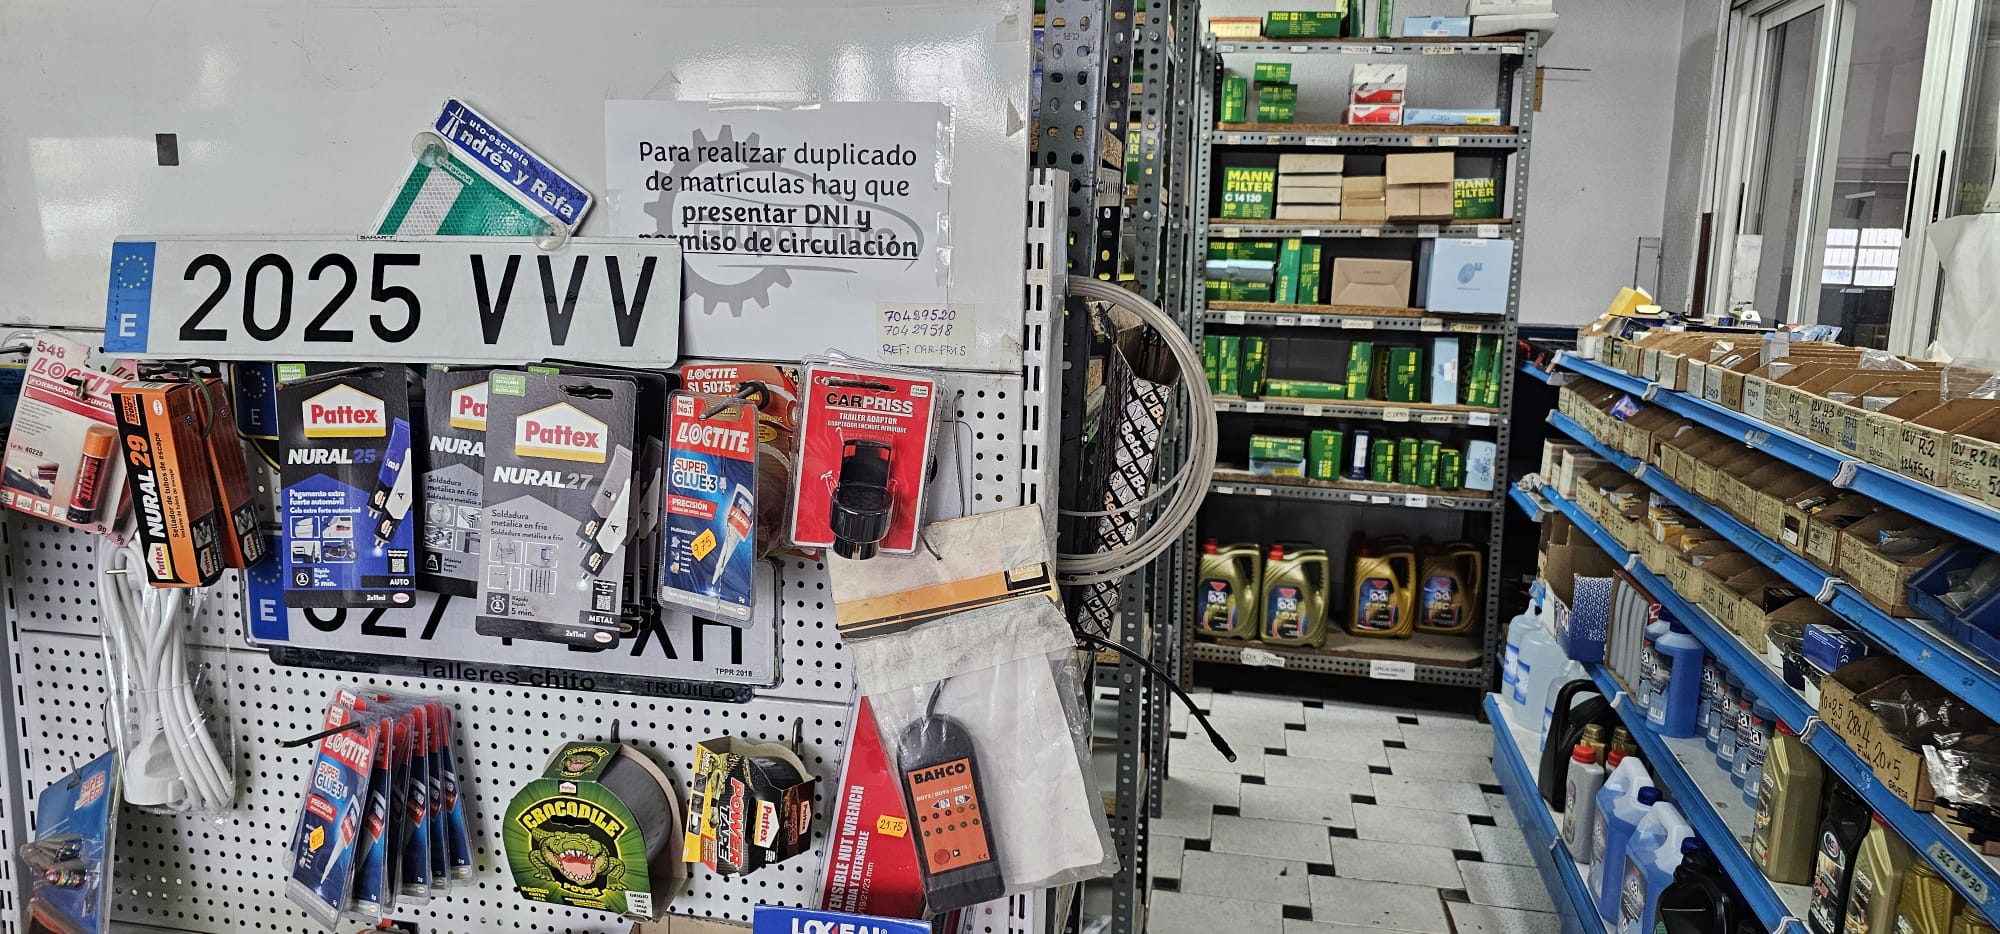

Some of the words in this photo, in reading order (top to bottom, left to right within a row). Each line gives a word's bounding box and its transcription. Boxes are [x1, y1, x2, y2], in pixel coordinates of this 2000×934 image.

[639, 141, 690, 162] Para
[697, 143, 787, 163] realizar
[793, 143, 917, 171] duplicado
[645, 171, 673, 191] de
[680, 172, 805, 195] matriculas
[811, 173, 857, 201] hay
[864, 178, 910, 202] que
[1227, 170, 1274, 183] MANN
[1454, 179, 1494, 190] MANN
[513, 170, 529, 186] y
[530, 178, 575, 219] Rafa
[1224, 192, 1233, 202] C
[1227, 181, 1273, 193] FILTER
[1454, 187, 1495, 199] FILTER
[682, 204, 798, 228] presentar
[804, 204, 849, 226] DNI
[857, 210, 872, 232] y
[638, 232, 737, 252] miso
[744, 231, 773, 252] de
[778, 233, 918, 258] circulación
[179, 253, 422, 342] 2025
[469, 253, 658, 348] VVV
[119, 313, 137, 337] E
[884, 310, 957, 322] 70429520
[884, 323, 953, 337] 70429518
[36, 340, 66, 359] 548
[31, 357, 120, 397] LOCTIT
[686, 367, 738, 380] LOCTITE
[30, 378, 75, 398] FORMADOR
[702, 380, 732, 394] 5075
[826, 392, 914, 414] CARPRISS
[251, 408, 261, 425] E
[310, 404, 378, 425] Pattex
[839, 412, 866, 422] TRAILER
[866, 416, 898, 425] ADAPTOR
[525, 420, 599, 449] Pattex
[675, 422, 750, 453] LOCTITE
[1121, 421, 1145, 457] Beta
[1901, 428, 1917, 446] 12V
[126, 434, 152, 468] 29
[154, 432, 165, 458] escape
[1951, 441, 1967, 457] 12V
[160, 459, 167, 470] de
[674, 459, 707, 475] SUPER
[162, 470, 170, 492] tubos
[427, 475, 462, 487] Soldadura
[427, 484, 456, 495] metálica
[456, 488, 465, 496] en
[138, 469, 166, 539] NURAL
[166, 493, 173, 504] de
[289, 489, 327, 500] Pegamento
[289, 506, 303, 514] Cola
[491, 509, 529, 521] Soldadura
[167, 504, 179, 539] Sellador
[491, 519, 523, 529] metálica
[490, 528, 521, 538] Soldadura
[157, 546, 167, 577] Pattex
[314, 579, 319, 587] 5
[389, 578, 410, 587] AUTO
[260, 599, 277, 622] E
[511, 607, 517, 615] 5
[588, 615, 614, 625] METAL
[416, 658, 519, 685] Talleres
[528, 669, 597, 692] chito
[714, 668, 735, 676] TPPR
[736, 669, 753, 678] 2018
[643, 680, 737, 701] TRUJILLO
[325, 732, 370, 768] LOCTITE
[319, 762, 339, 778] SUPER
[913, 763, 966, 784] BAHCO
[80, 770, 106, 792] SUPER
[522, 801, 620, 837] CROCODILE
[843, 785, 864, 838] WRENCH
[730, 777, 745, 868] POWER
[760, 805, 772, 843] Pattex
[719, 805, 731, 863] TAPE
[839, 839, 854, 861] NUT
[850, 830, 870, 881] EXTENSIBLE
[863, 861, 874, 877] mm
[563, 882, 602, 896] POWER
[829, 863, 850, 912] TENSIBLE
